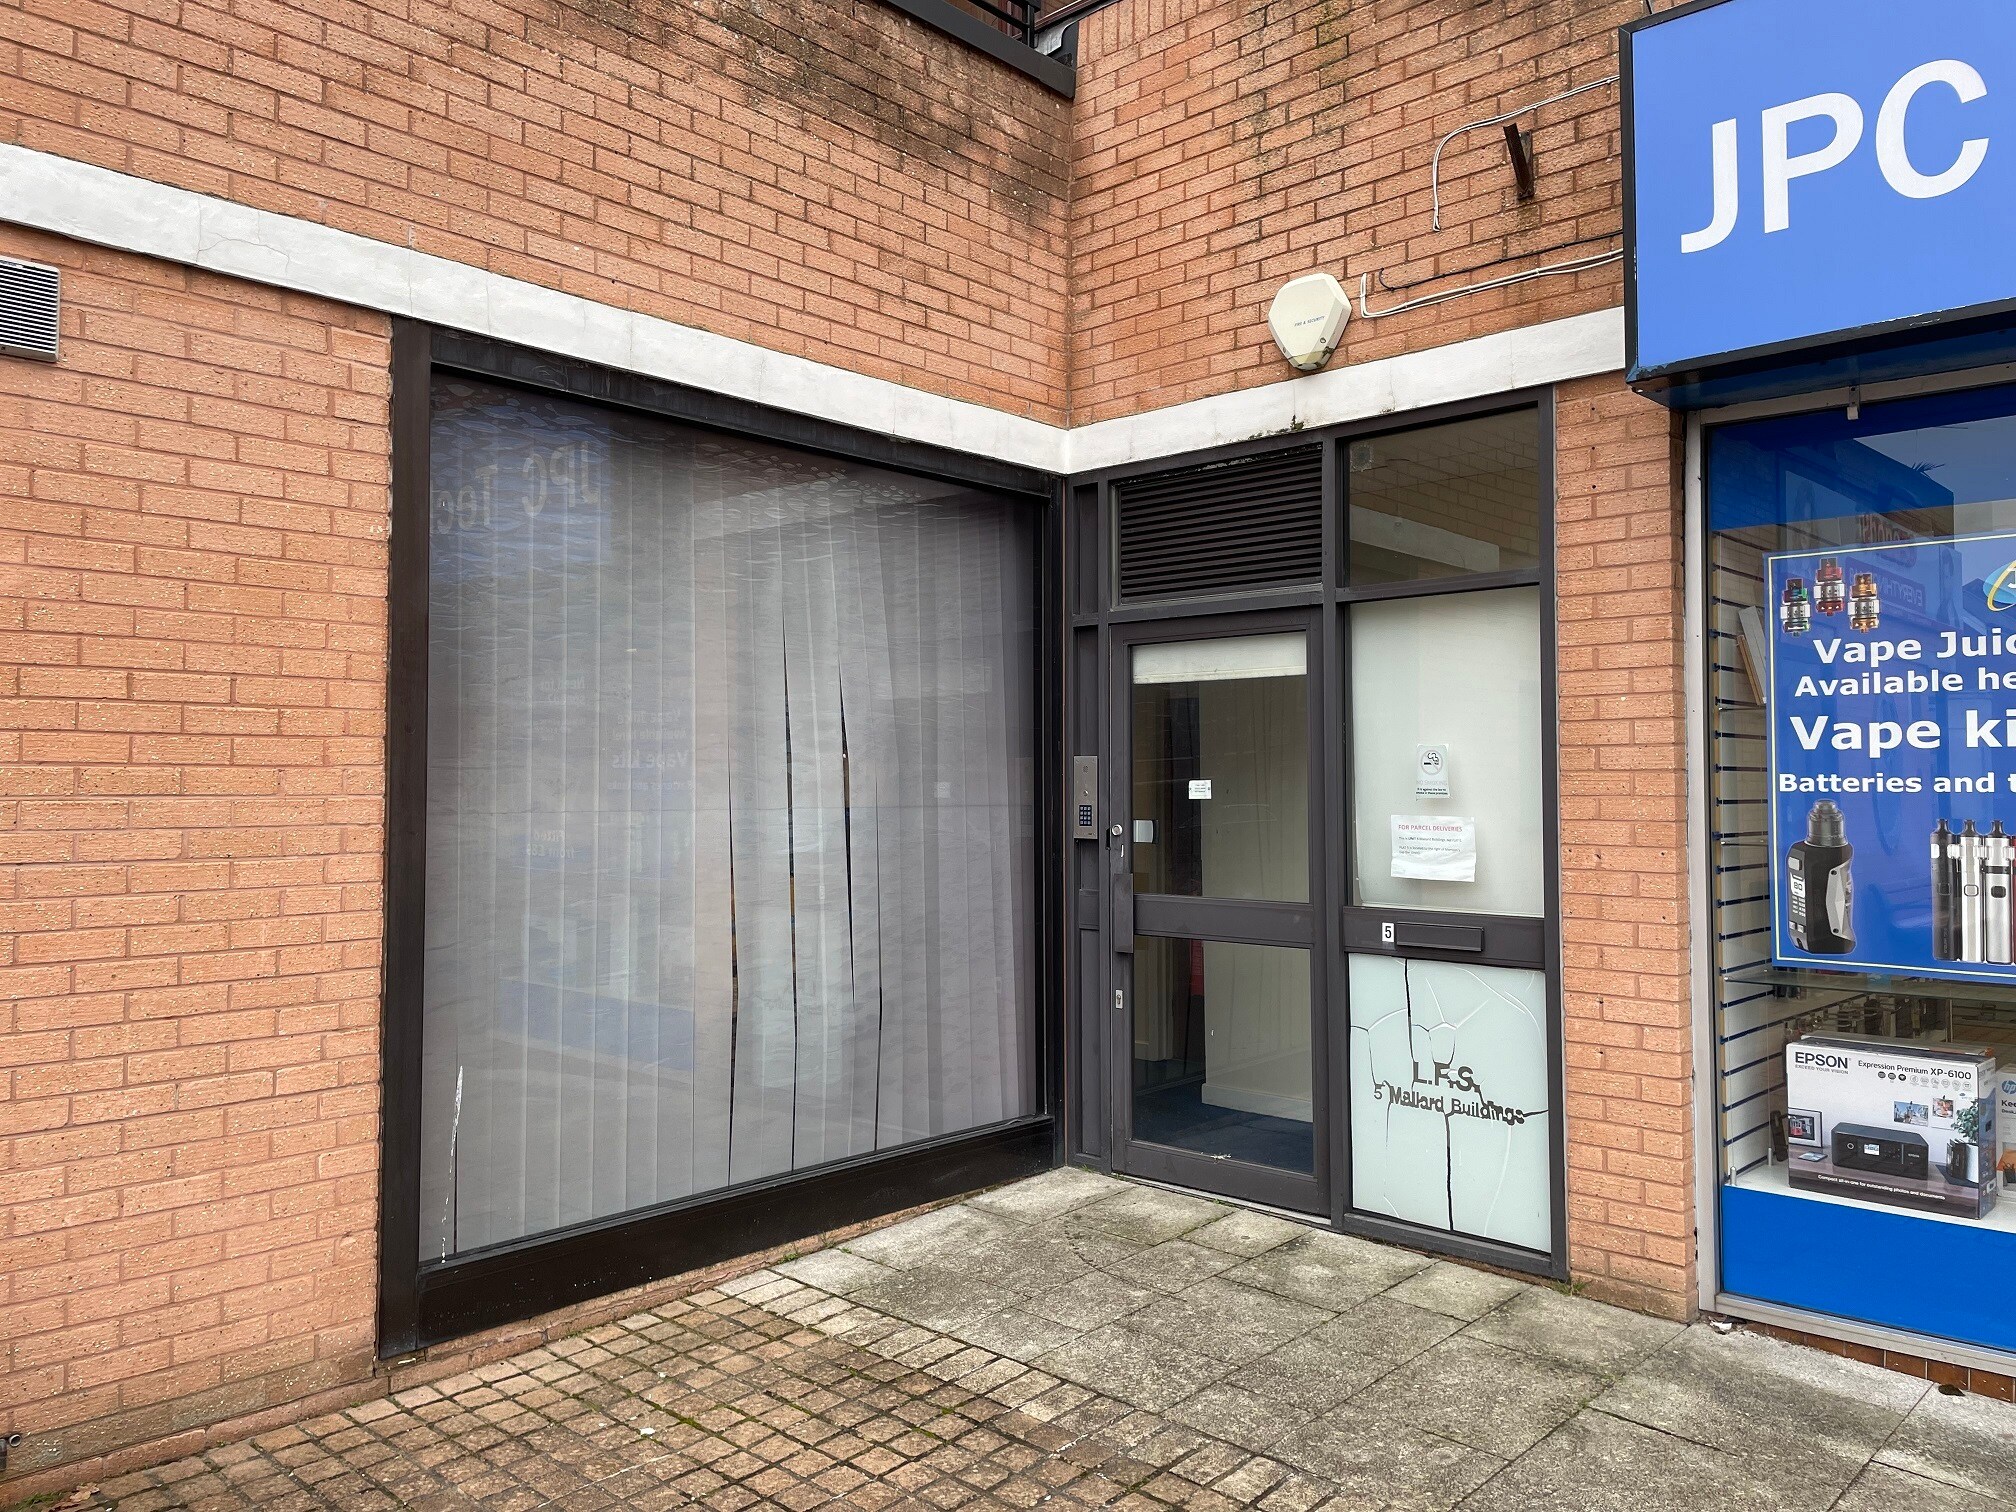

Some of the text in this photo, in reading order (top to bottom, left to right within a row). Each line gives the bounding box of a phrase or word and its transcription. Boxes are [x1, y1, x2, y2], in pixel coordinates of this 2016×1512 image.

[1681, 59, 1989, 254] JPC
[1812, 637, 1922, 668] Vape
[1794, 667, 2016, 697] Available he
[1789, 708, 2016, 759] Vape ki
[1779, 772, 1923, 793] Batteries
[1933, 771, 1995, 793] and
[1384, 926, 1392, 939] 5
[1795, 1051, 1848, 1069] EPSON
[1858, 1060, 1895, 1071] Expression
[1896, 1064, 1928, 1075] Premium
[1930, 1067, 1971, 1080] XP-6100
[1374, 1083, 1525, 1126] 5 Mallard Buildings
[1866, 1183, 1893, 1192] outstanding
